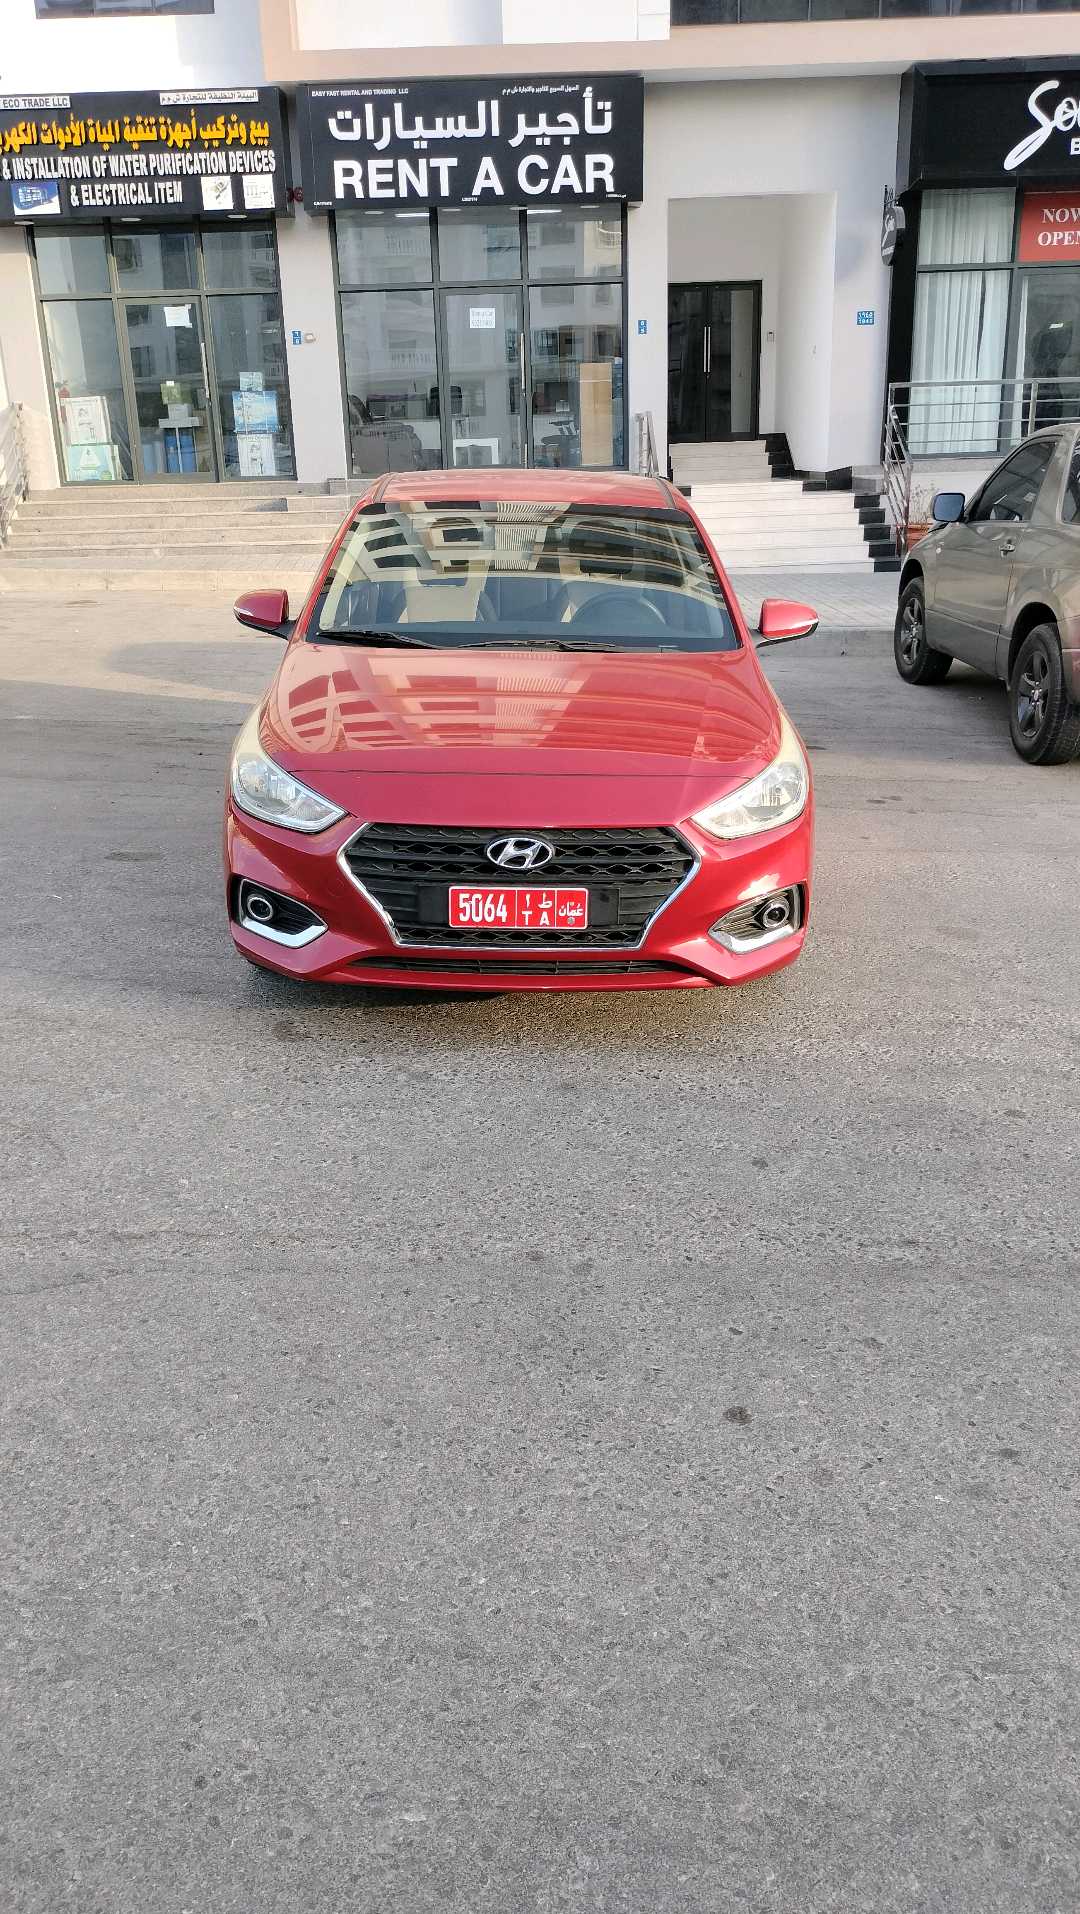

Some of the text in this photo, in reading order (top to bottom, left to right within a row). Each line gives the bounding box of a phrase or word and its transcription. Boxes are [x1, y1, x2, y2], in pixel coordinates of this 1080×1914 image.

[2, 97, 68, 108] ECO TRADE LLC
[340, 89, 360, 97] RENTAL
[123, 114, 158, 152] تنقية
[158, 108, 197, 149] أجهزة
[199, 112, 247, 149] وتركيب
[249, 120, 270, 147] بيع
[328, 87, 612, 151] تأجير السيارات
[1003, 79, 1080, 171] So
[2, 149, 276, 180] & INSTALLATION OF WATER PURIFICATION DEVICES
[333, 153, 615, 200] RENT A CAR
[70, 184, 80, 207] &
[81, 180, 153, 206] ELECTRICAL
[153, 180, 183, 204] ITEM
[458, 893, 508, 923] 5064
